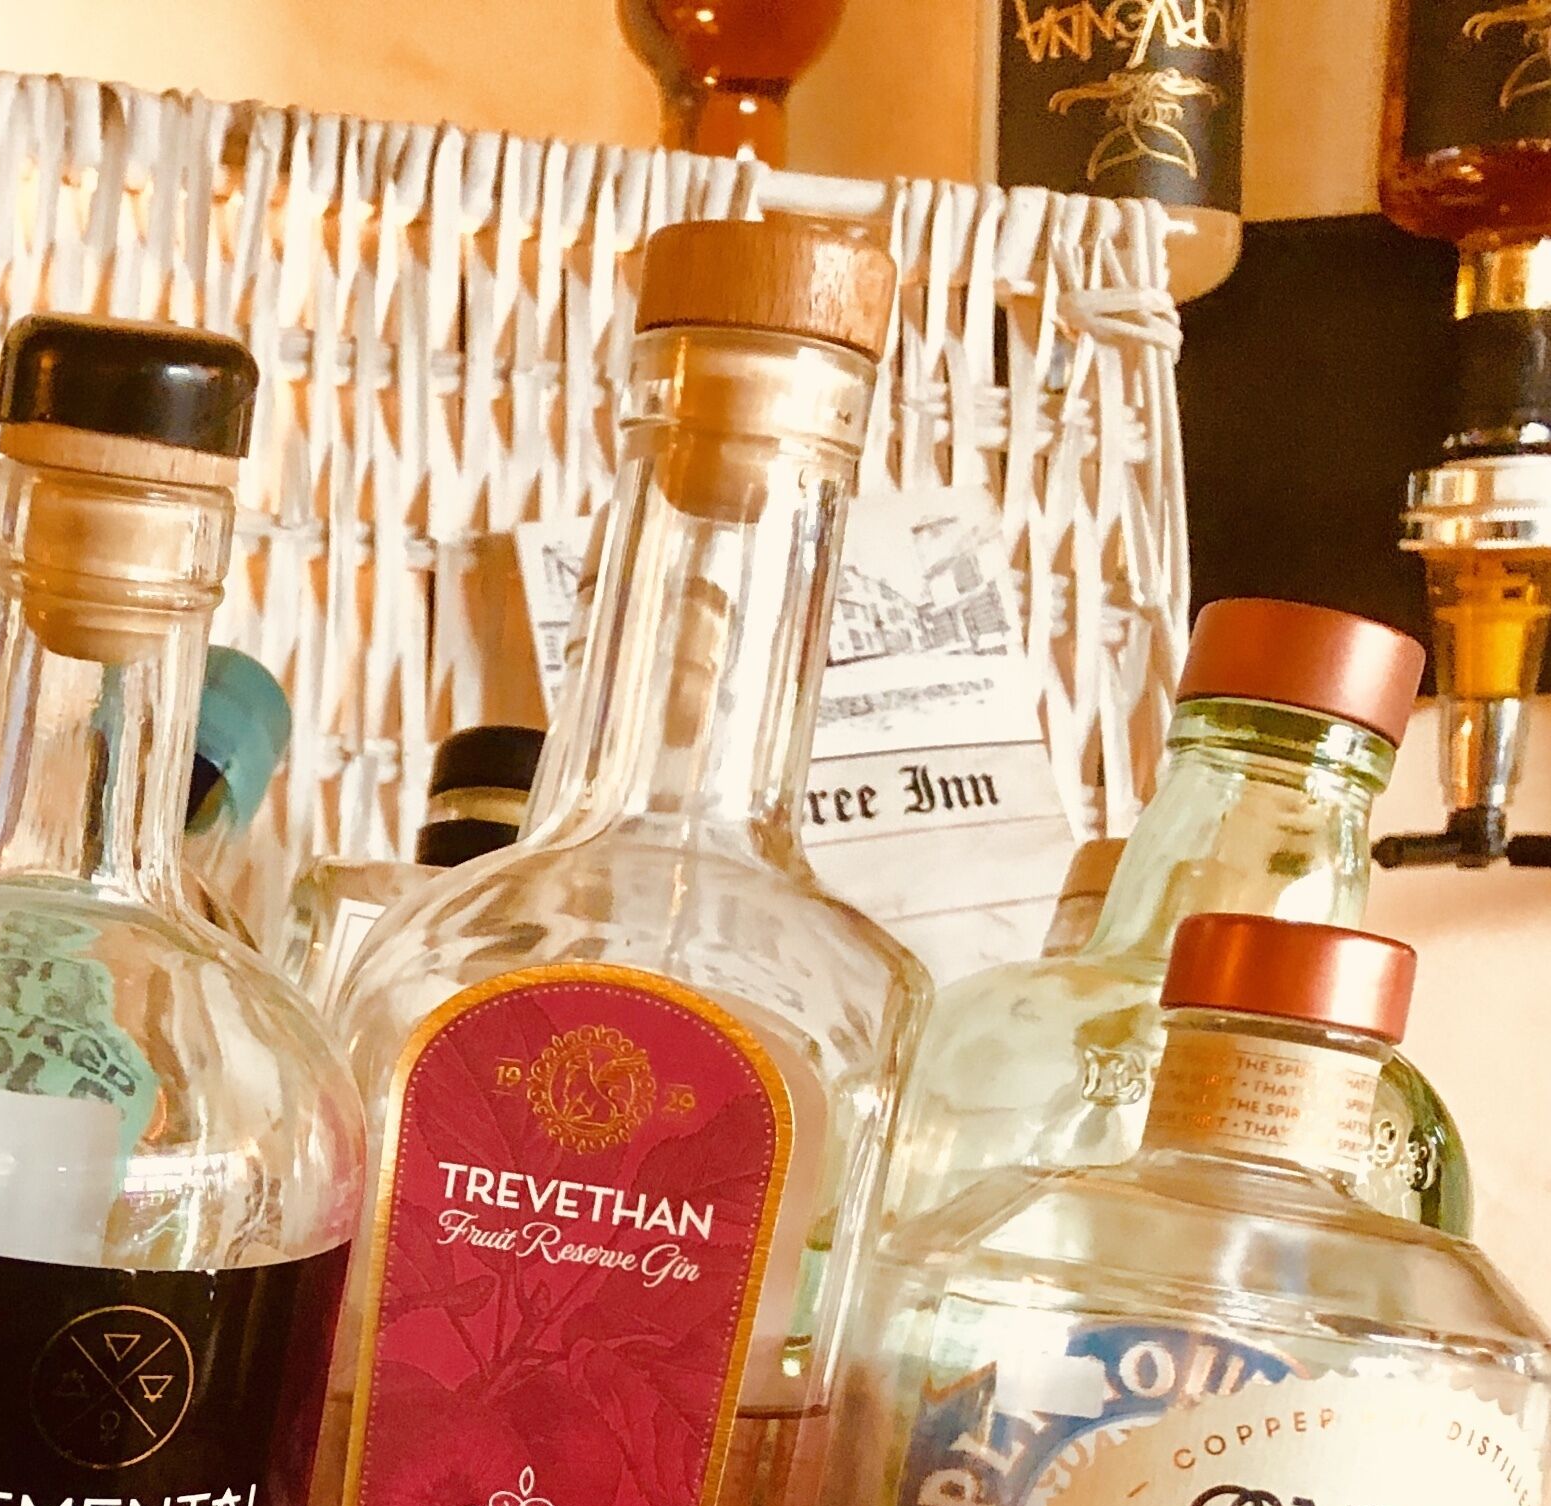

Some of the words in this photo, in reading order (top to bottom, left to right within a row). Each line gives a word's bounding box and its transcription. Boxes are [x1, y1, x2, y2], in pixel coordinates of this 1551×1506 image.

[803, 783, 880, 826] ree
[897, 763, 1000, 815] Inn
[494, 1062, 522, 1088] 19
[663, 1089, 696, 1115] 29
[438, 1161, 714, 1241] TREVETHAN
[437, 1208, 517, 1252] Fruit
[518, 1221, 637, 1271] Reserve
[641, 1244, 700, 1288] Gin
